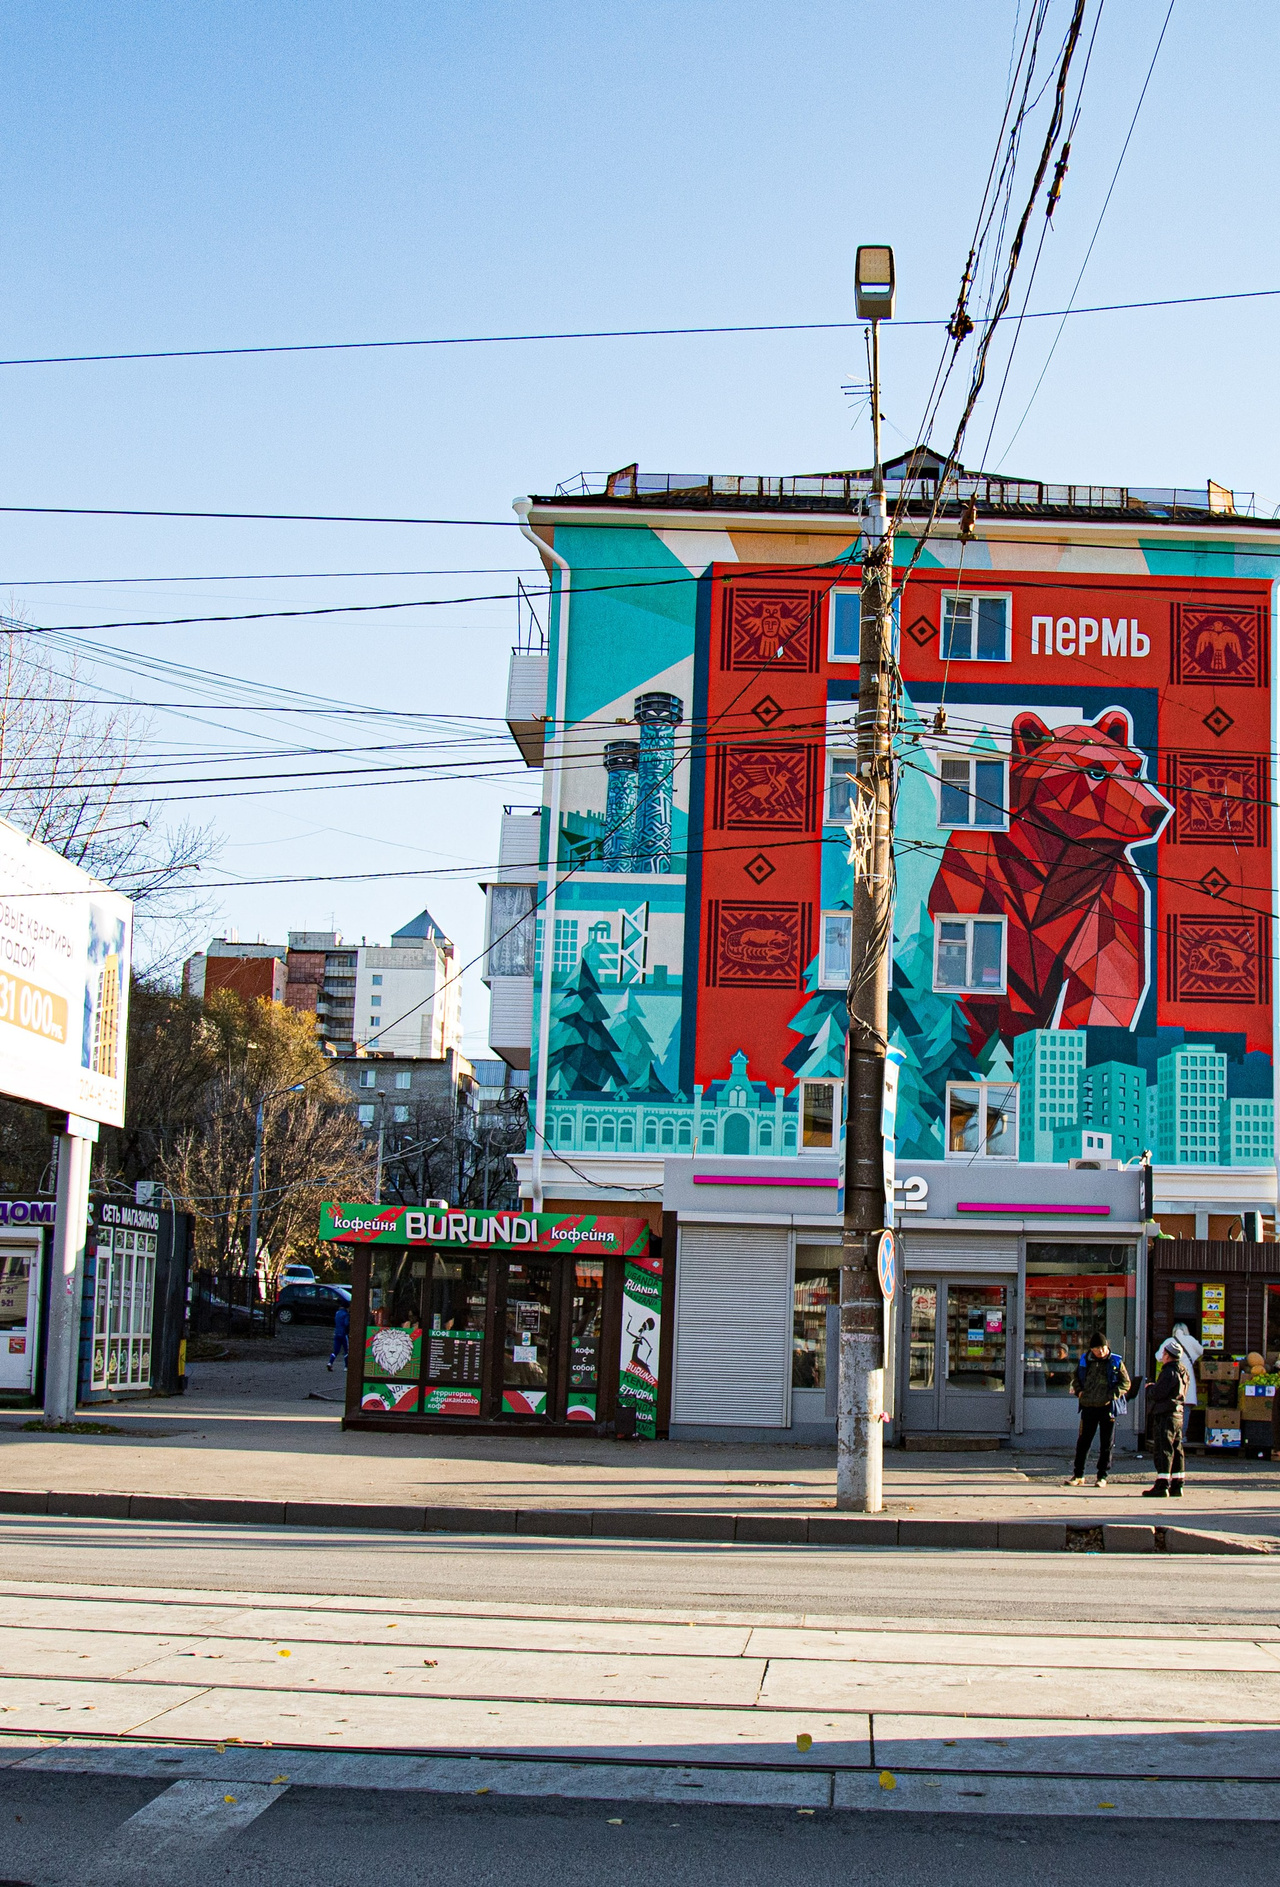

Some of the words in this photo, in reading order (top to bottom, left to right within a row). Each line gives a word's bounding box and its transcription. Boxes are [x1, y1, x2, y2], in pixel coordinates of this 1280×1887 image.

[27, 917, 74, 959] КВАРТИРЫ
[0, 936, 35, 971] ГОДОЙ
[20, 983, 53, 1034] 000
[103, 1204, 121, 1224] СЕТЬ
[122, 1207, 159, 1231] МАГАЗИНОВ
[334, 1215, 397, 1232] кофейня
[405, 1212, 538, 1244] BURUNDI
[551, 1226, 615, 1244] кофейня
[625, 1279, 659, 1295] RUANDA
[575, 1347, 595, 1356] кофе
[572, 1363, 596, 1372] собой
[430, 1396, 479, 1405] африканского
[433, 1390, 472, 1398] территория
[619, 1384, 654, 1402] ETHIOPIA
